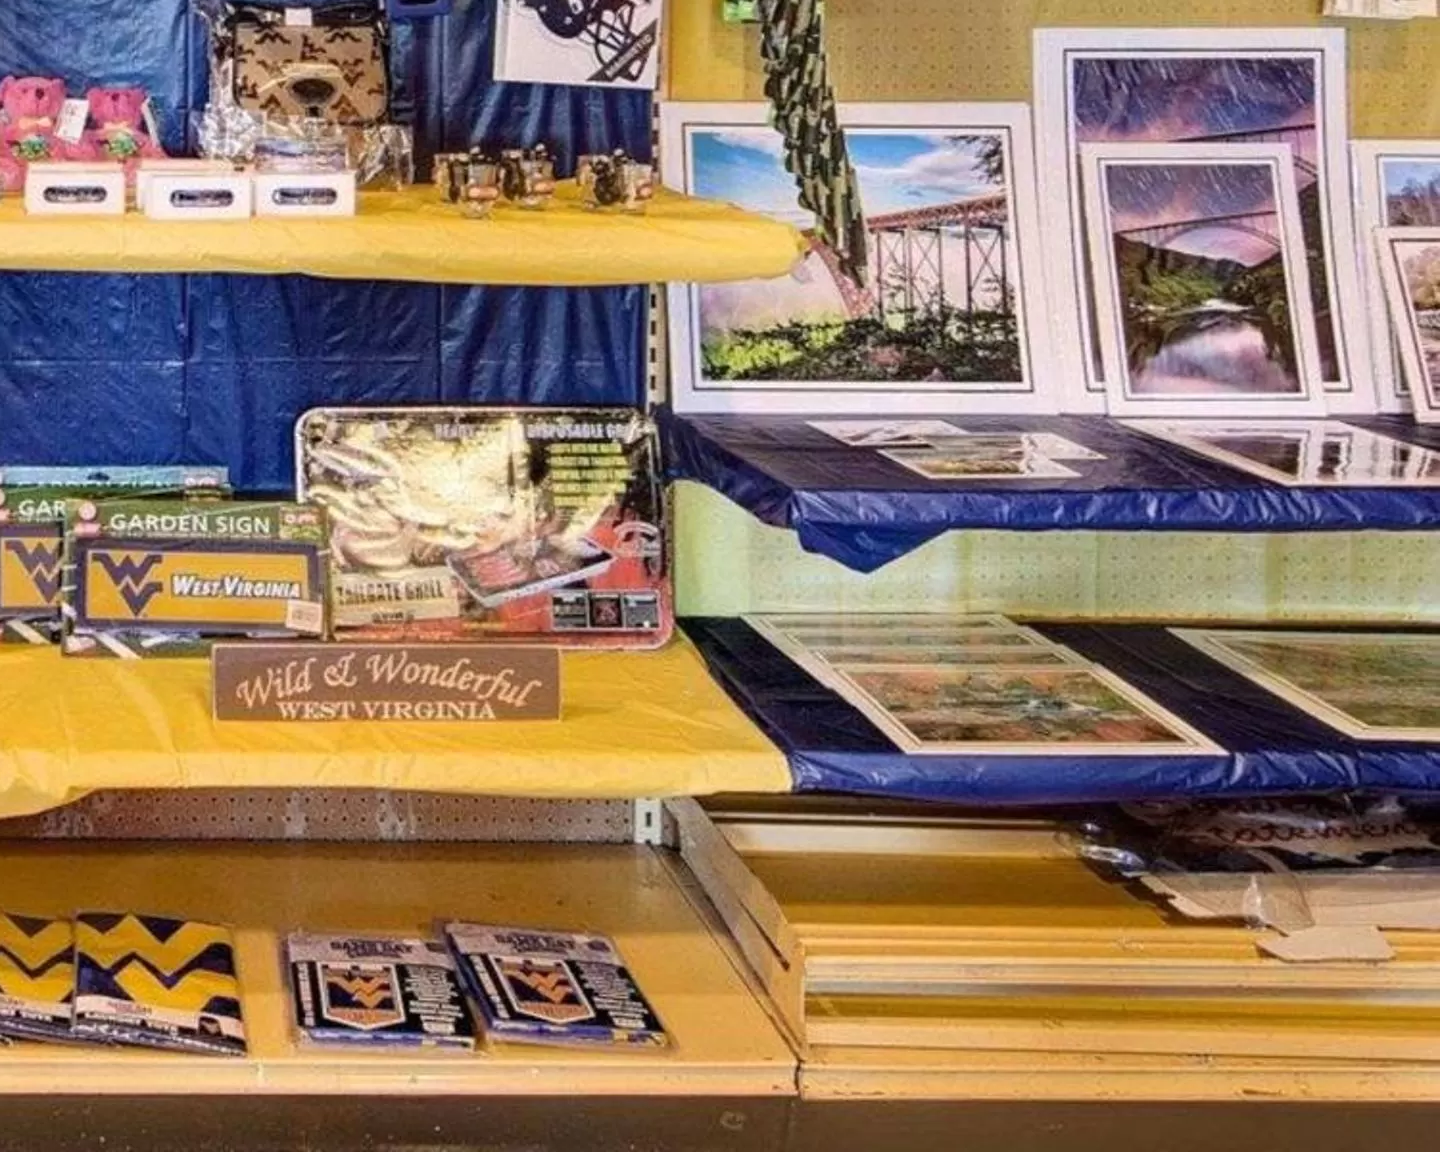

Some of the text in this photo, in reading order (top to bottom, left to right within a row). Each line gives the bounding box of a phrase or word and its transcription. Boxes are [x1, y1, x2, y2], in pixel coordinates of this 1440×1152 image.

[18, 499, 66, 518] GAR
[110, 513, 271, 535] GARDEN SIGN
[171, 573, 302, 598] WEST VIRGINIA
[235, 651, 543, 710] Wild & Wonderful
[275, 700, 497, 721] WEST VIRGINIA
